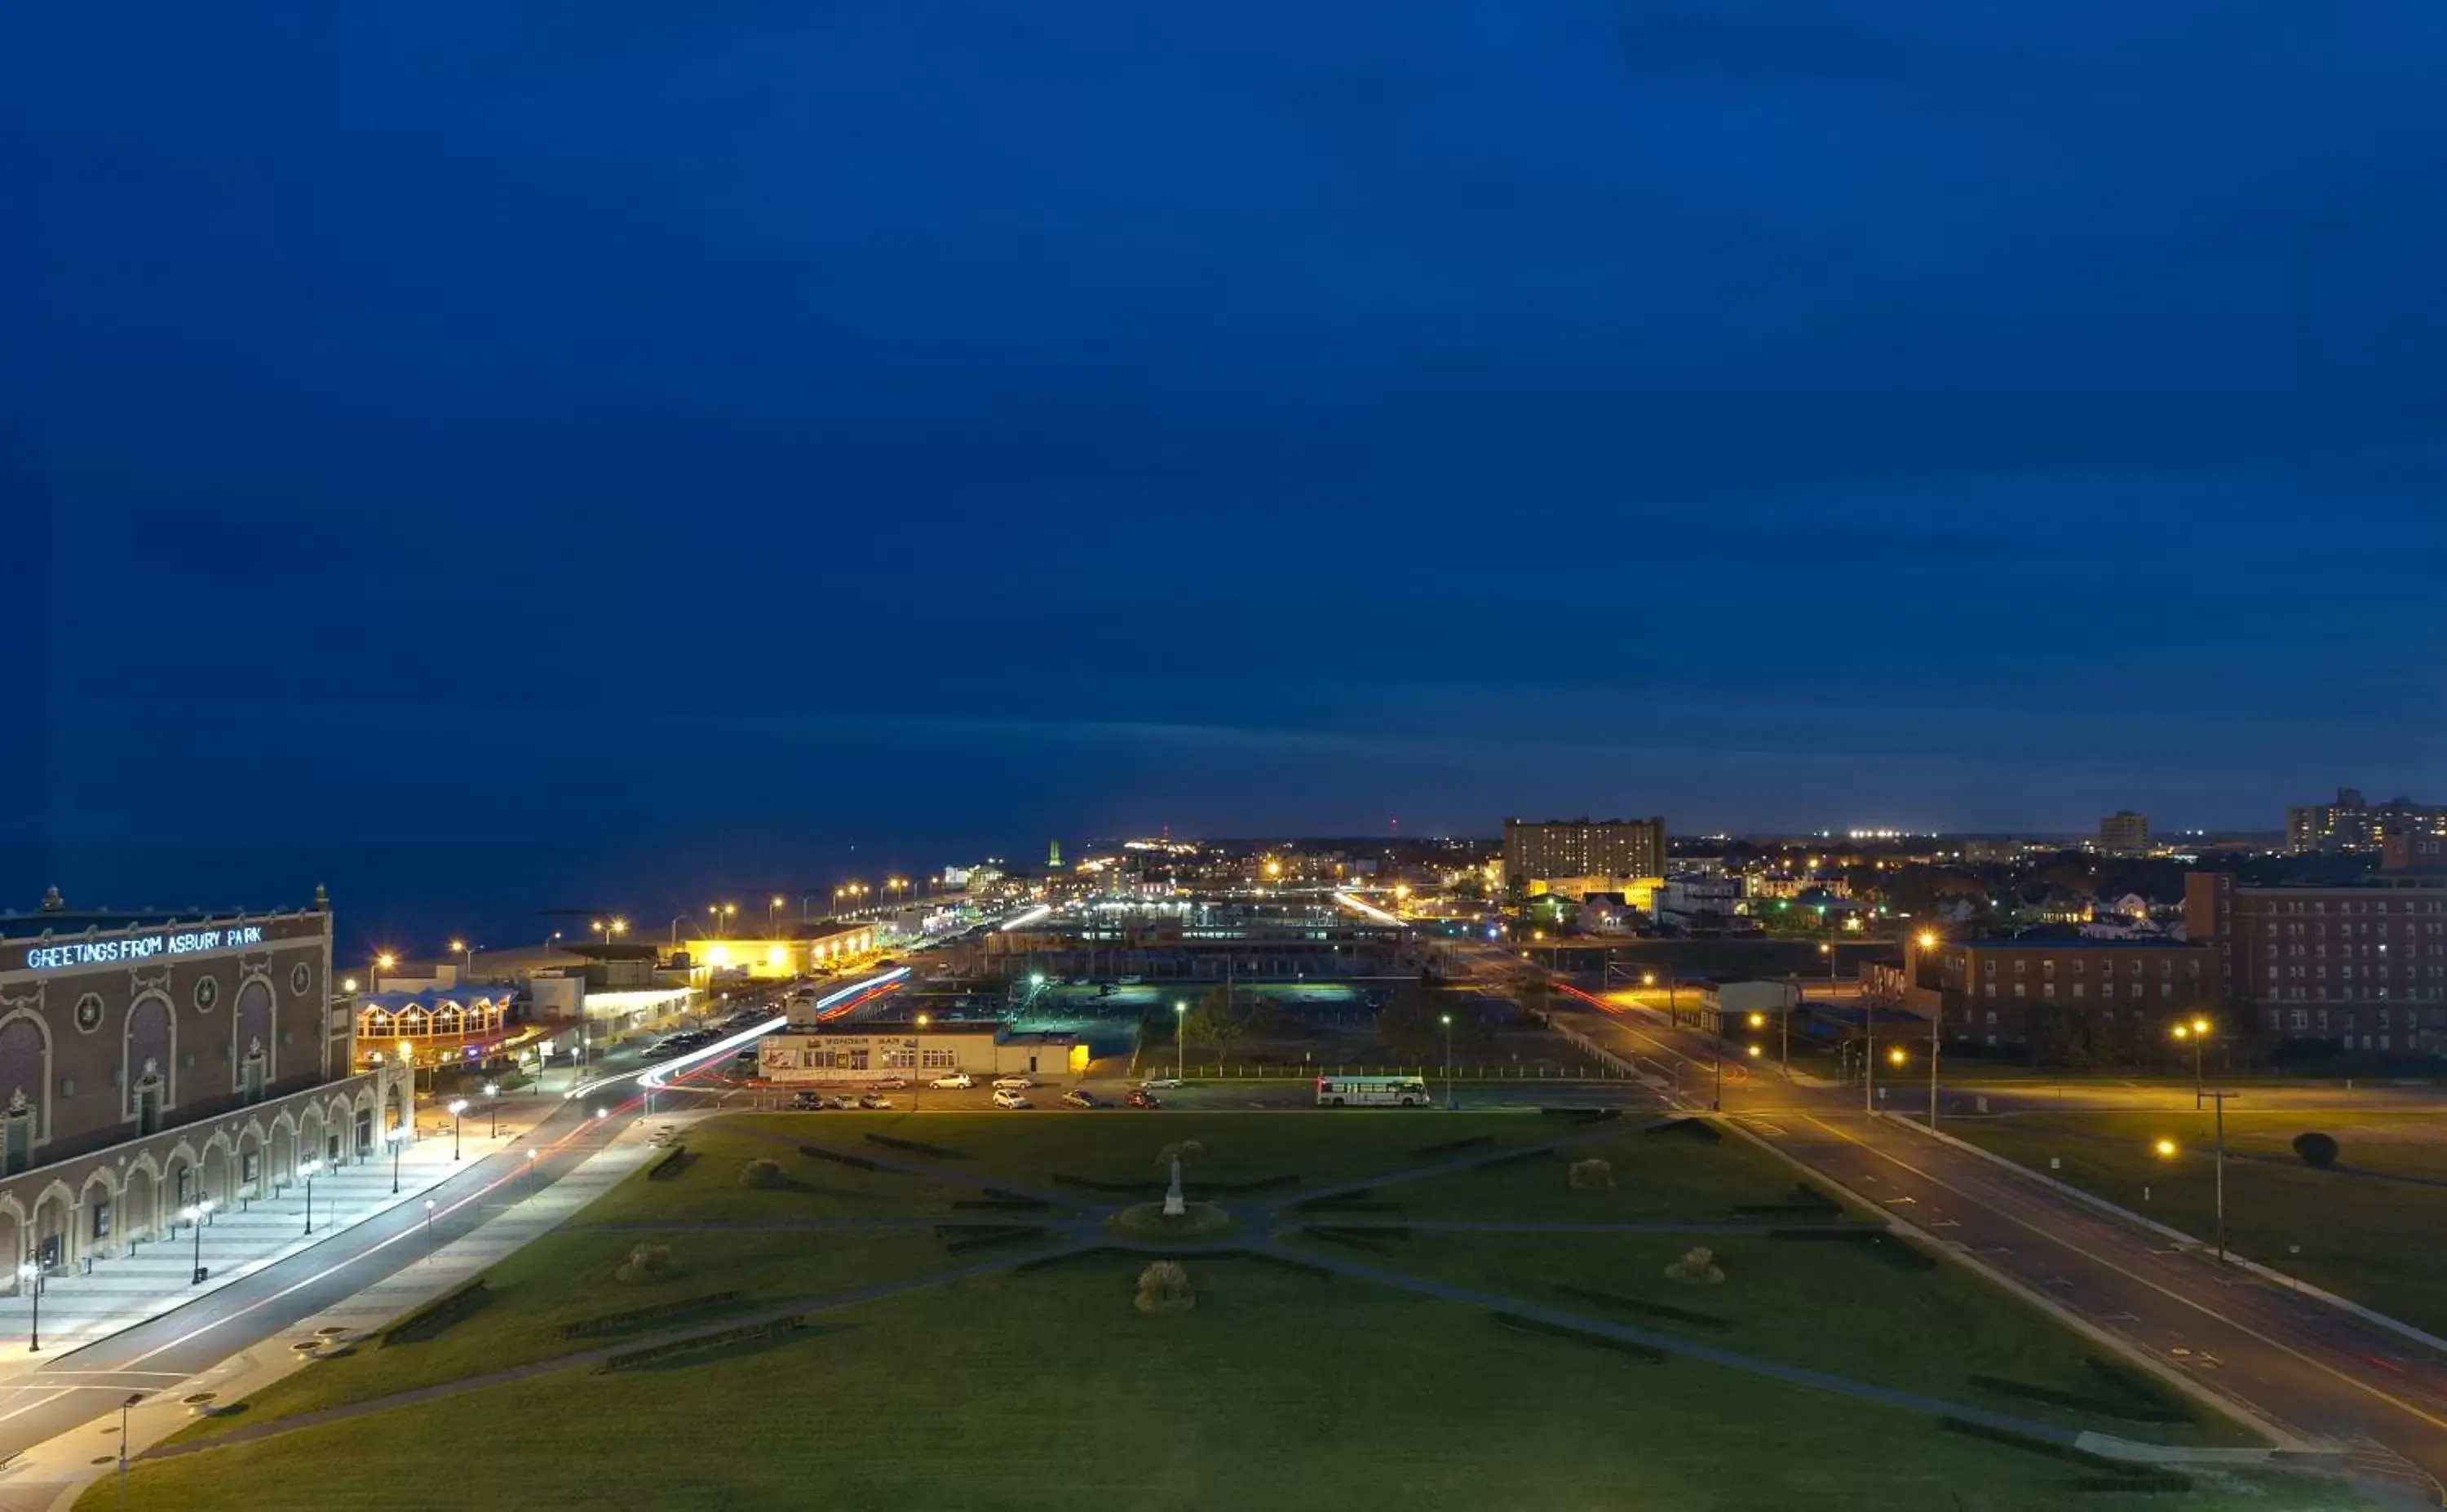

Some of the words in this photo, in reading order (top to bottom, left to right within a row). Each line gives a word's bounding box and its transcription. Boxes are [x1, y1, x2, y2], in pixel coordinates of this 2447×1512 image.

[28, 942, 118, 968] GREETINGS
[122, 936, 162, 958] FROM
[168, 931, 221, 953] ASBURY
[228, 926, 262, 947] PARK
